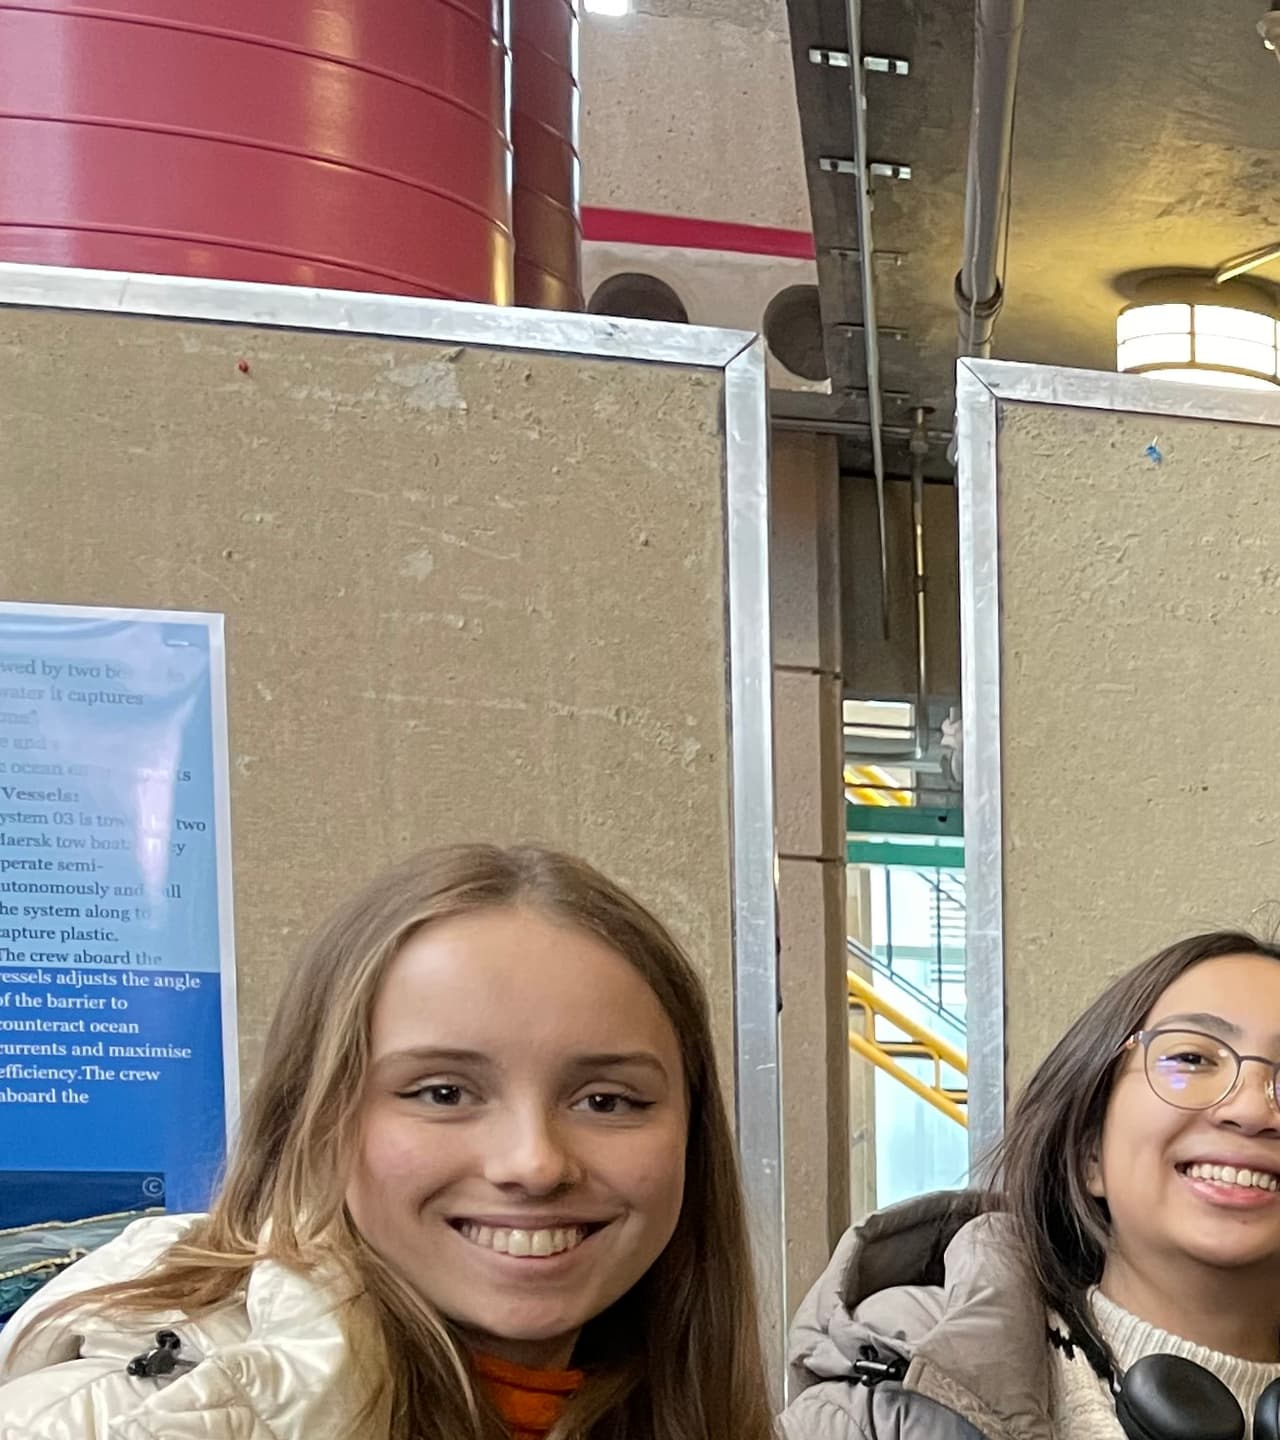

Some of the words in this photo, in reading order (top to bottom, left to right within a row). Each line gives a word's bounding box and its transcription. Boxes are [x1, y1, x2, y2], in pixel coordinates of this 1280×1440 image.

[41, 660, 63, 680] by
[68, 663, 101, 680] two
[67, 690, 145, 707] captures
[2, 786, 80, 803] Vessels:
[53, 811, 74, 826] 03
[79, 813, 95, 827] is
[176, 818, 207, 832] two
[56, 836, 86, 850] tow
[57, 860, 105, 873] semi-
[113, 883, 145, 898] and
[23, 905, 81, 919] system
[85, 903, 131, 922] along
[60, 926, 120, 944] plastic.
[30, 950, 70, 963] crew
[73, 950, 131, 965] aboard
[135, 952, 163, 966] the
[56, 972, 119, 989] adjusts
[121, 971, 151, 987] the
[154, 973, 202, 992] angle
[15, 993, 44, 1009] the
[47, 993, 108, 1010] barrier
[111, 996, 129, 1011] to
[89, 1022, 141, 1036] ocean
[71, 1042, 105, 1058] and
[108, 1043, 193, 1059] maximise
[119, 1069, 162, 1082] crew
[61, 1089, 90, 1105] the
